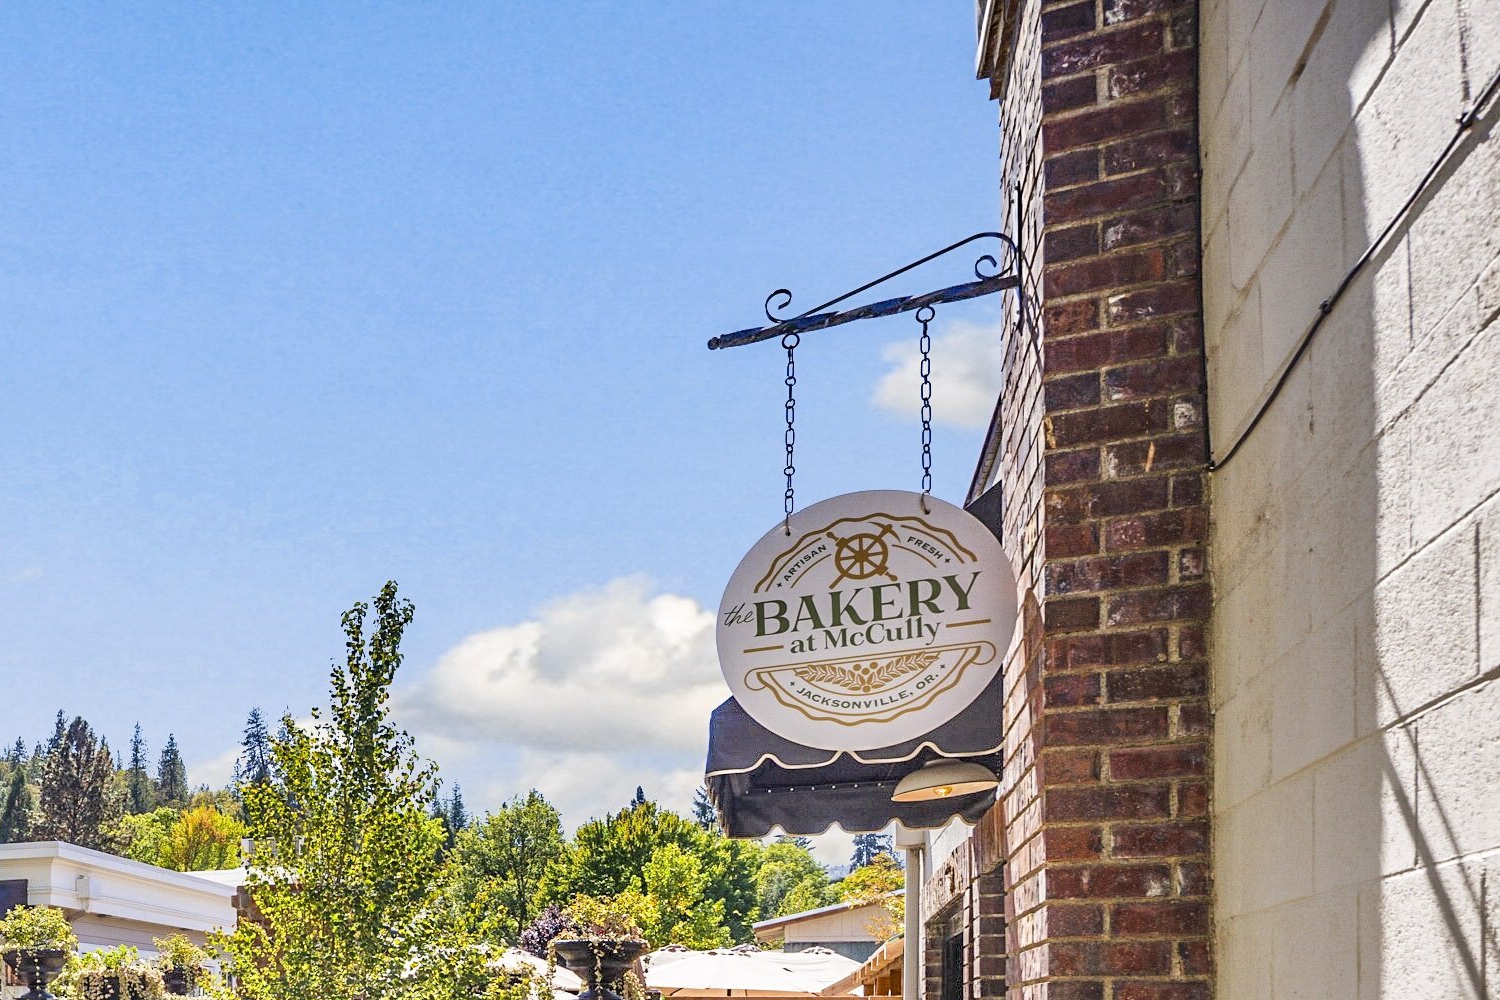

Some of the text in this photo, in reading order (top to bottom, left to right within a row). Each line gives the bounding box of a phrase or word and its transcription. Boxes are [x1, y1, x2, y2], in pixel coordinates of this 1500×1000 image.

[783, 536, 943, 582] ARTISAN FRESH
[723, 571, 983, 638] the BAKERY
[790, 617, 942, 654] at McCully
[796, 673, 939, 709] JACKSONVILLE, OR.
